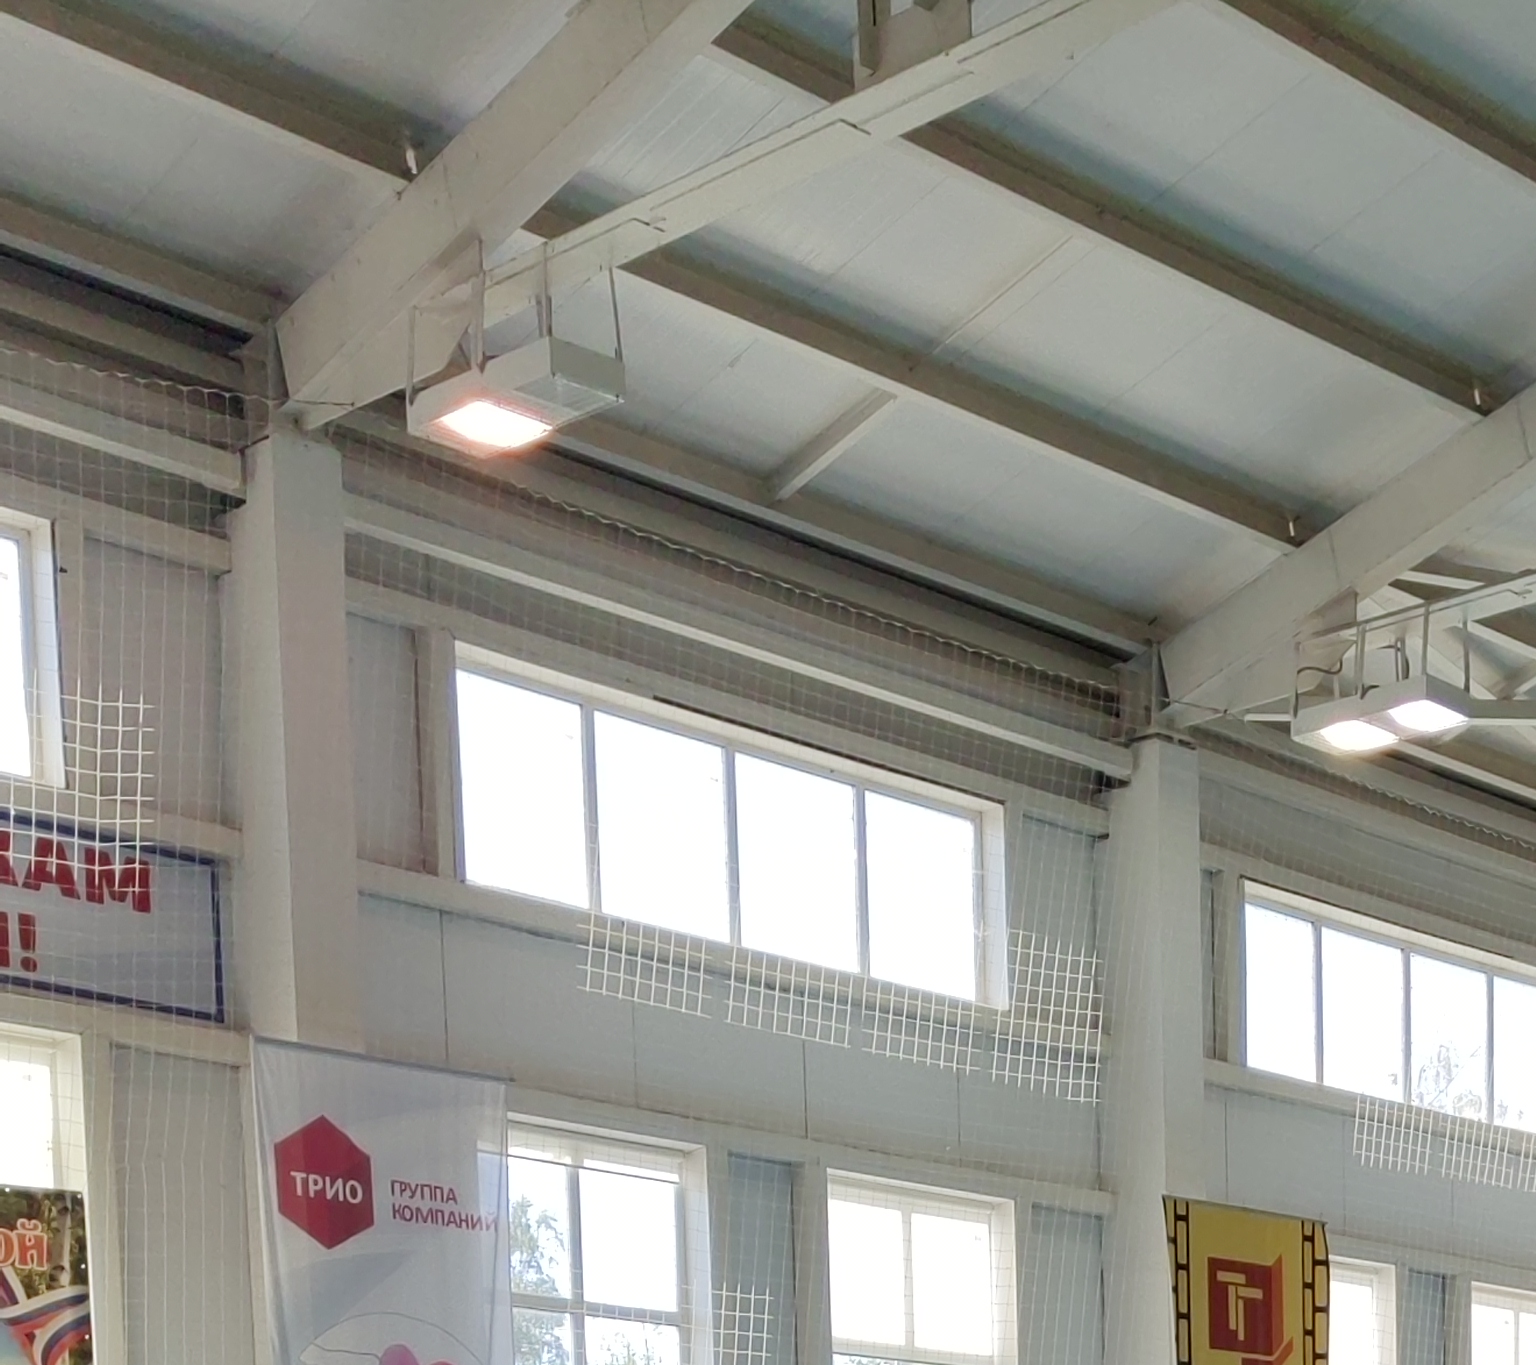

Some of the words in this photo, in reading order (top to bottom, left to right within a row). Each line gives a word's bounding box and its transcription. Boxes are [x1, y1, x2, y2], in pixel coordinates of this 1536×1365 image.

[289, 1170, 364, 1204] ТРИО
[390, 1179, 459, 1206] ГРУППА
[391, 1202, 499, 1233] КОМПАНИЙ
